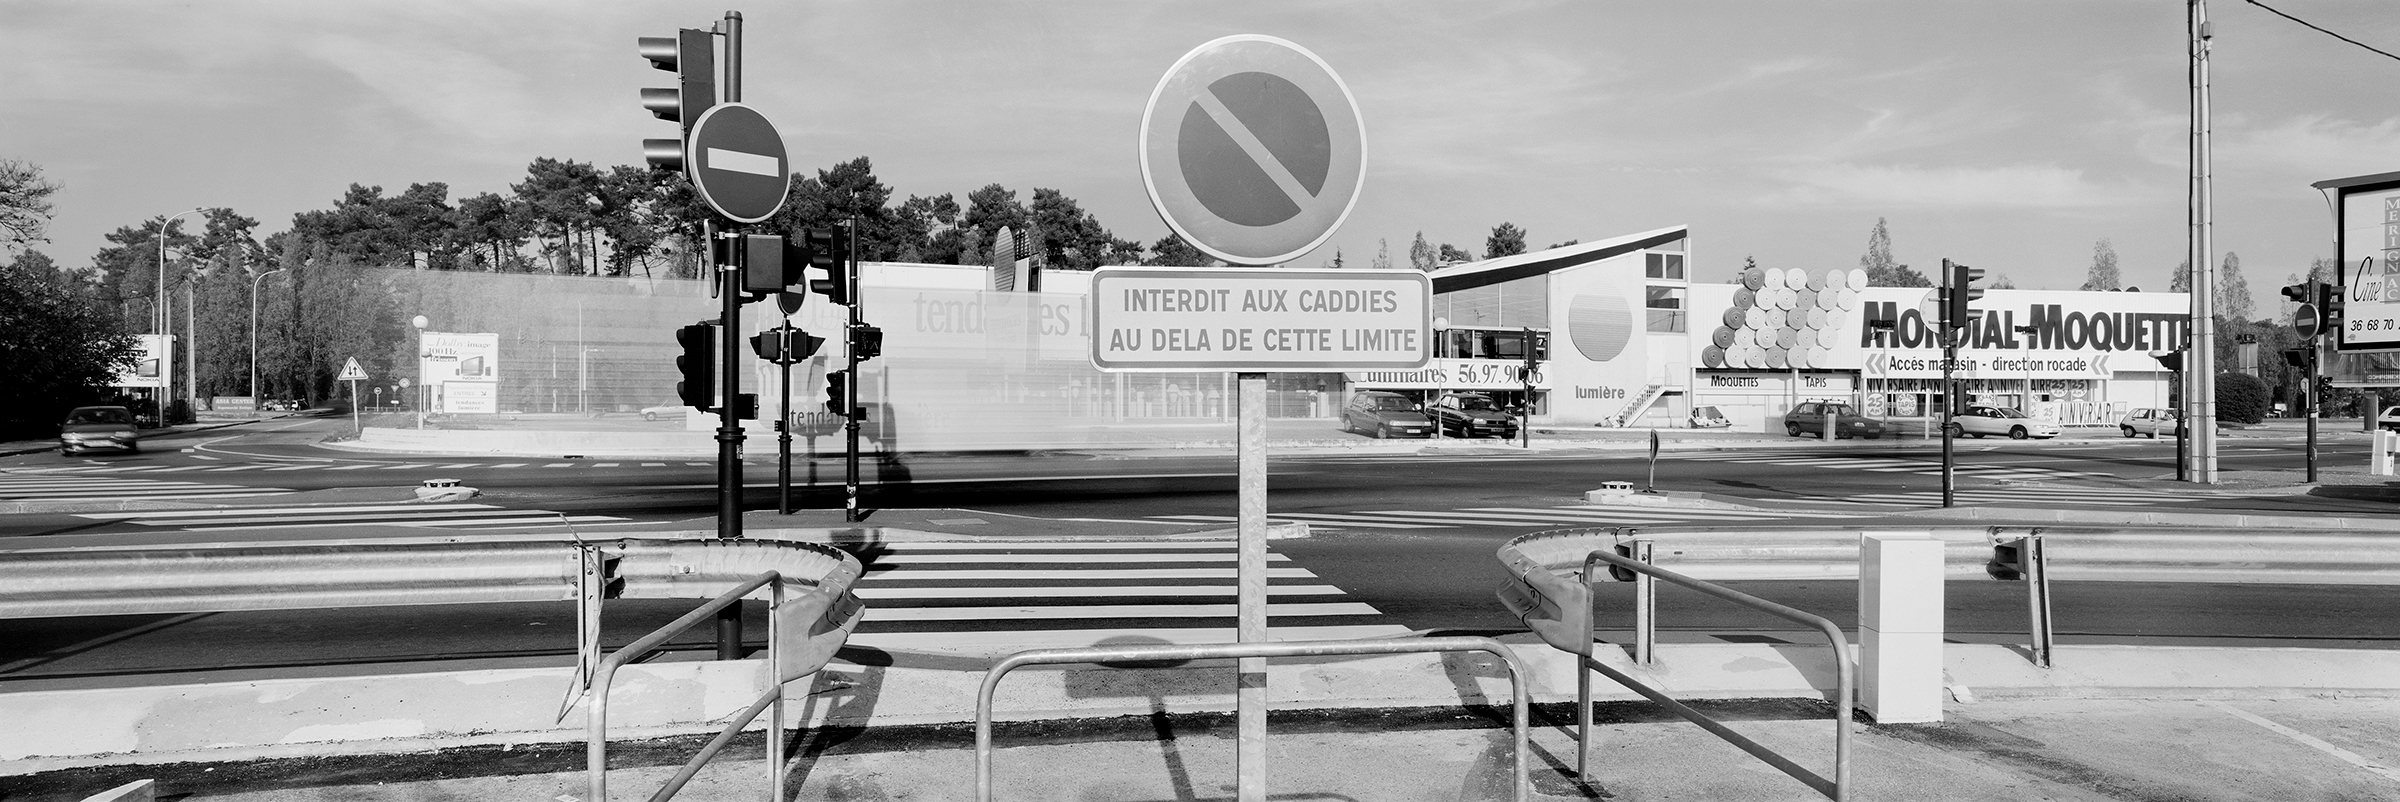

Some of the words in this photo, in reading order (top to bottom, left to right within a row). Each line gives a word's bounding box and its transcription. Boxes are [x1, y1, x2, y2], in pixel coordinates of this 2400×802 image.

[2353, 256, 2384, 302] Ciné
[1124, 289, 1230, 312] INTERDIT
[1242, 290, 1289, 312] AUX
[1299, 290, 1398, 313] CADDIES
[913, 289, 1070, 337] tendes
[2350, 320, 2363, 332] 36
[2366, 320, 2379, 332] 68
[2383, 319, 2394, 331] 70
[1109, 328, 1142, 351] AU
[1152, 329, 1212, 351] DELA
[1222, 329, 1253, 351] DE
[1263, 329, 1331, 351] CETTE
[1342, 329, 1416, 351] LIMITE
[1928, 357, 1977, 374] maasin
[2047, 356, 2087, 371] rocade
[1458, 364, 1544, 385] 56.97.9006
[1575, 385, 1625, 400] lumière
[2052, 380, 2066, 389] 25
[2072, 380, 2085, 389] 25
[1868, 397, 1883, 407] 25
